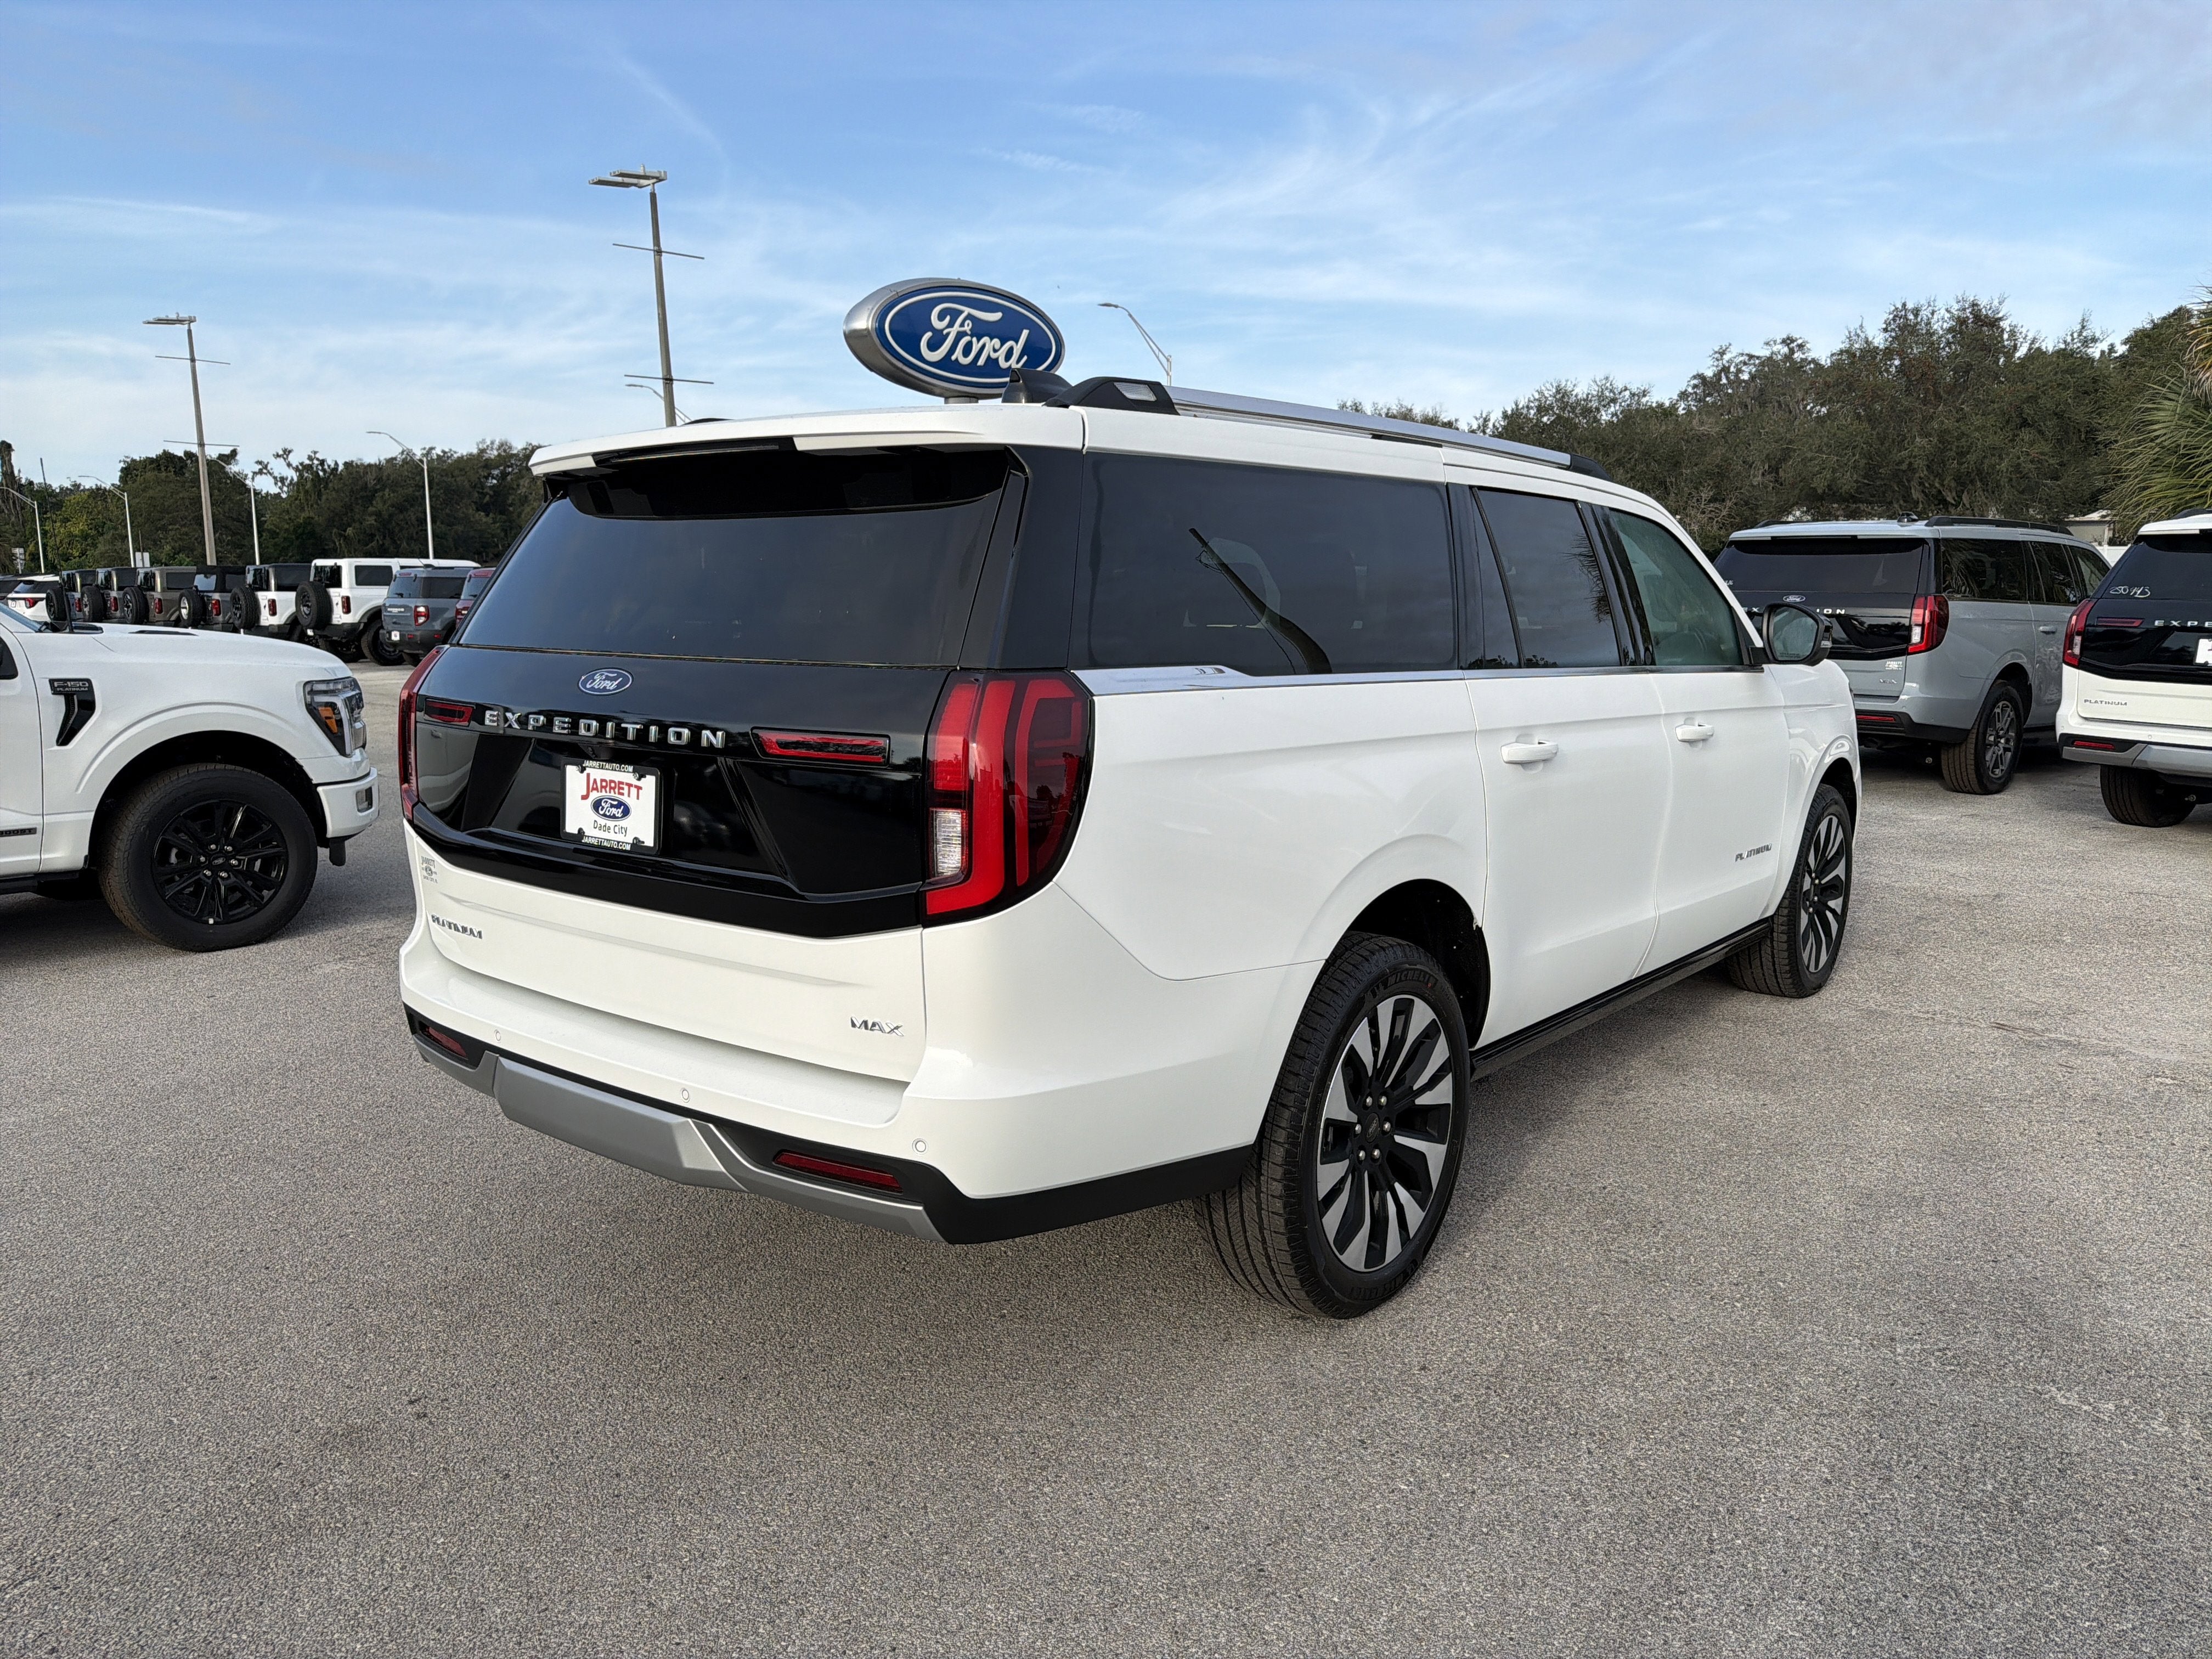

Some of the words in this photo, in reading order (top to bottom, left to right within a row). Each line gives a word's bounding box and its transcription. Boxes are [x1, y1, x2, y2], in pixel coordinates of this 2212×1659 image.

[920, 303, 1030, 369] Ford
[586, 672, 623, 690] Ford
[484, 710, 726, 749] EXPEDITION
[583, 760, 634, 772] JARRETTAUTO.COM
[580, 772, 643, 800] JARRETT
[599, 799, 624, 817] Ford
[593, 820, 611, 833] Dade
[613, 824, 628, 837] City
[582, 836, 631, 851] JARRETTAUTO.COM
[1735, 843, 1773, 862] PLATINUM
[431, 913, 483, 940] PLATINUM
[850, 1016, 905, 1037] MAX
